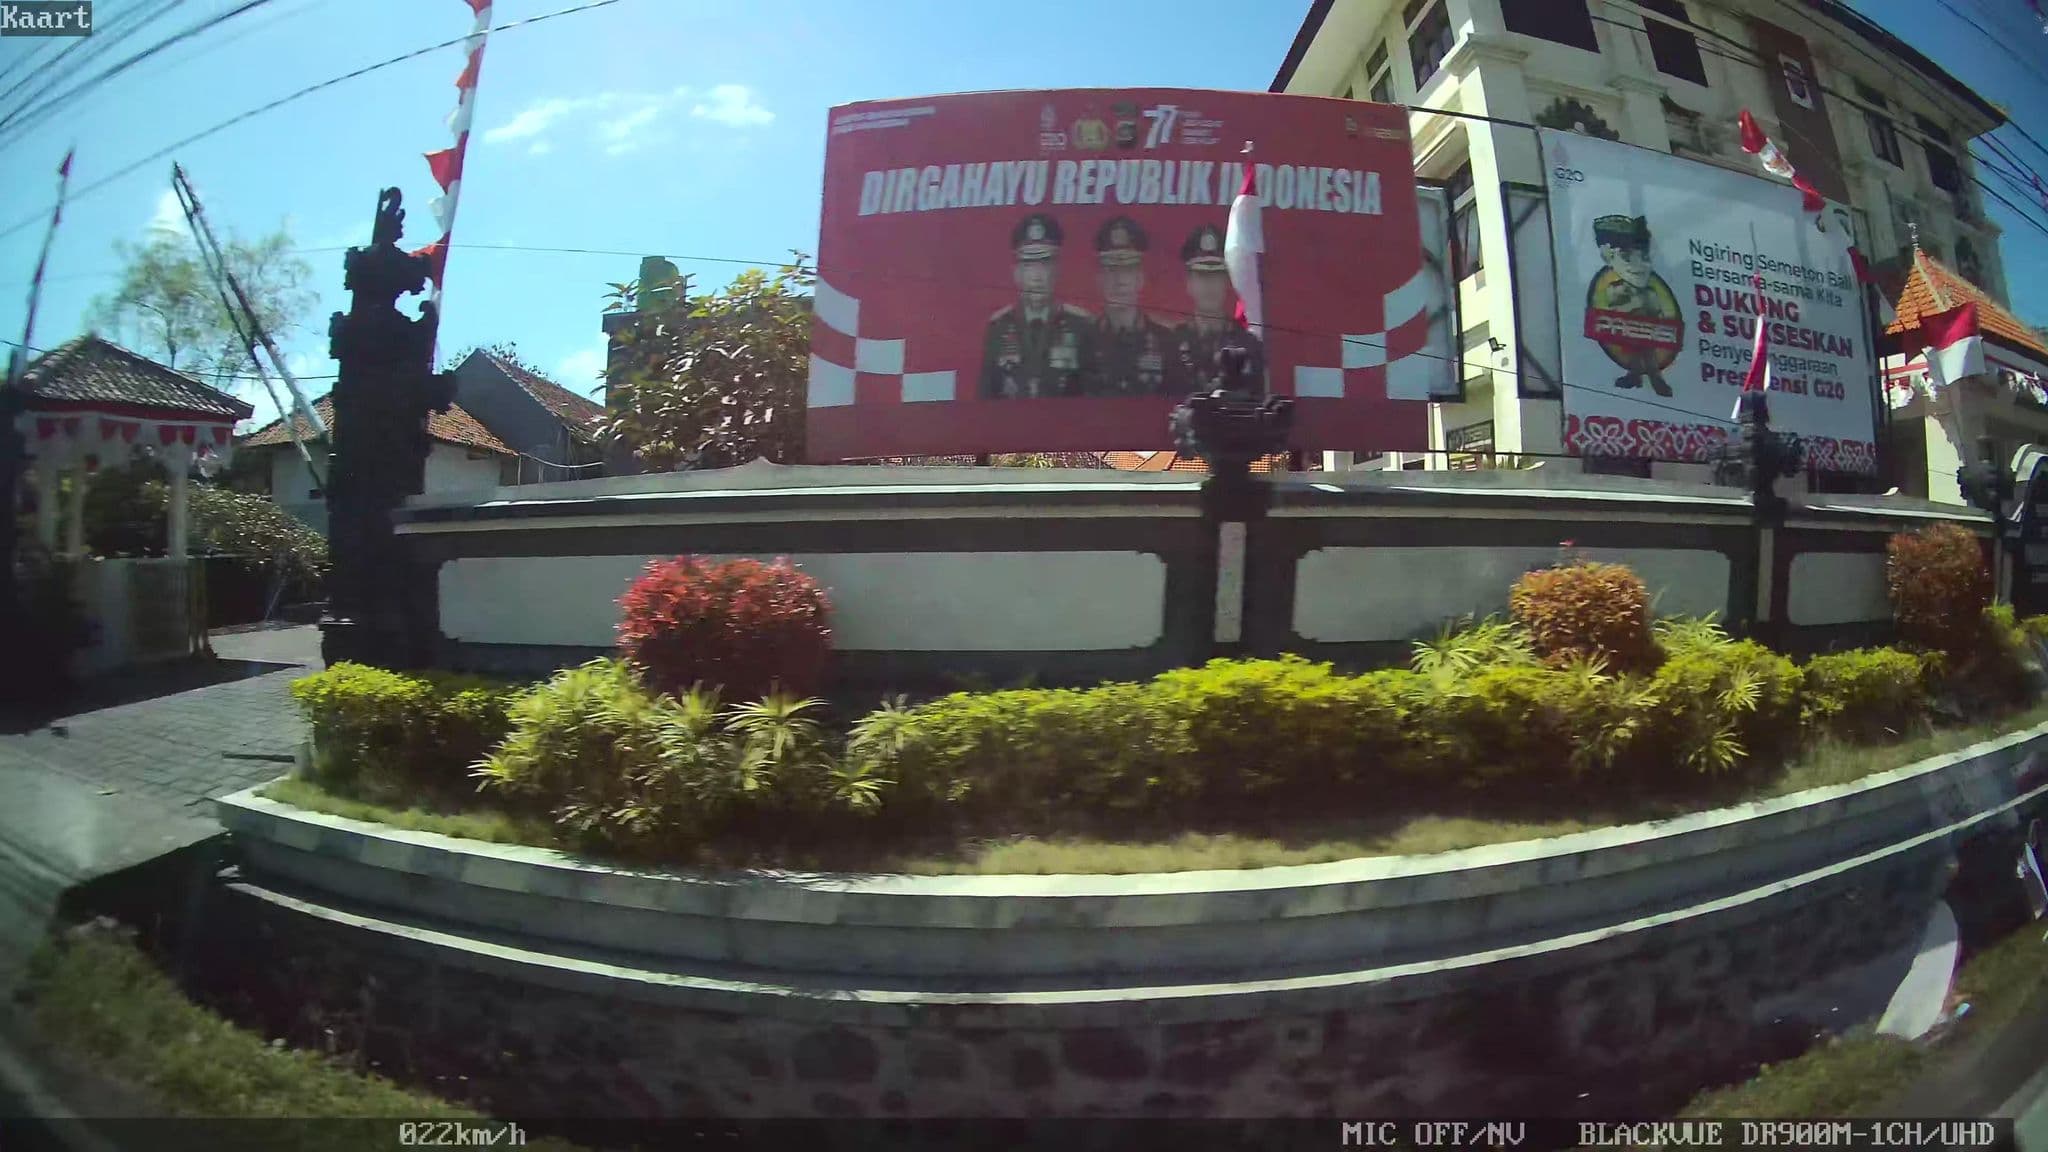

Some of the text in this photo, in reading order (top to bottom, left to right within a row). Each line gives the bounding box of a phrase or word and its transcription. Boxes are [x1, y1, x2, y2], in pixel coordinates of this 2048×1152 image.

[858, 159, 1049, 216] DIRGAHAYU
[1052, 159, 1214, 205] REPUBLIK
[1689, 238, 1852, 291] Ngiring Semeton Bali
[1816, 287, 1843, 308] Kita
[1697, 310, 1716, 334] &
[1722, 314, 1853, 360] SUSESKAN
[1813, 378, 1846, 401] G20
